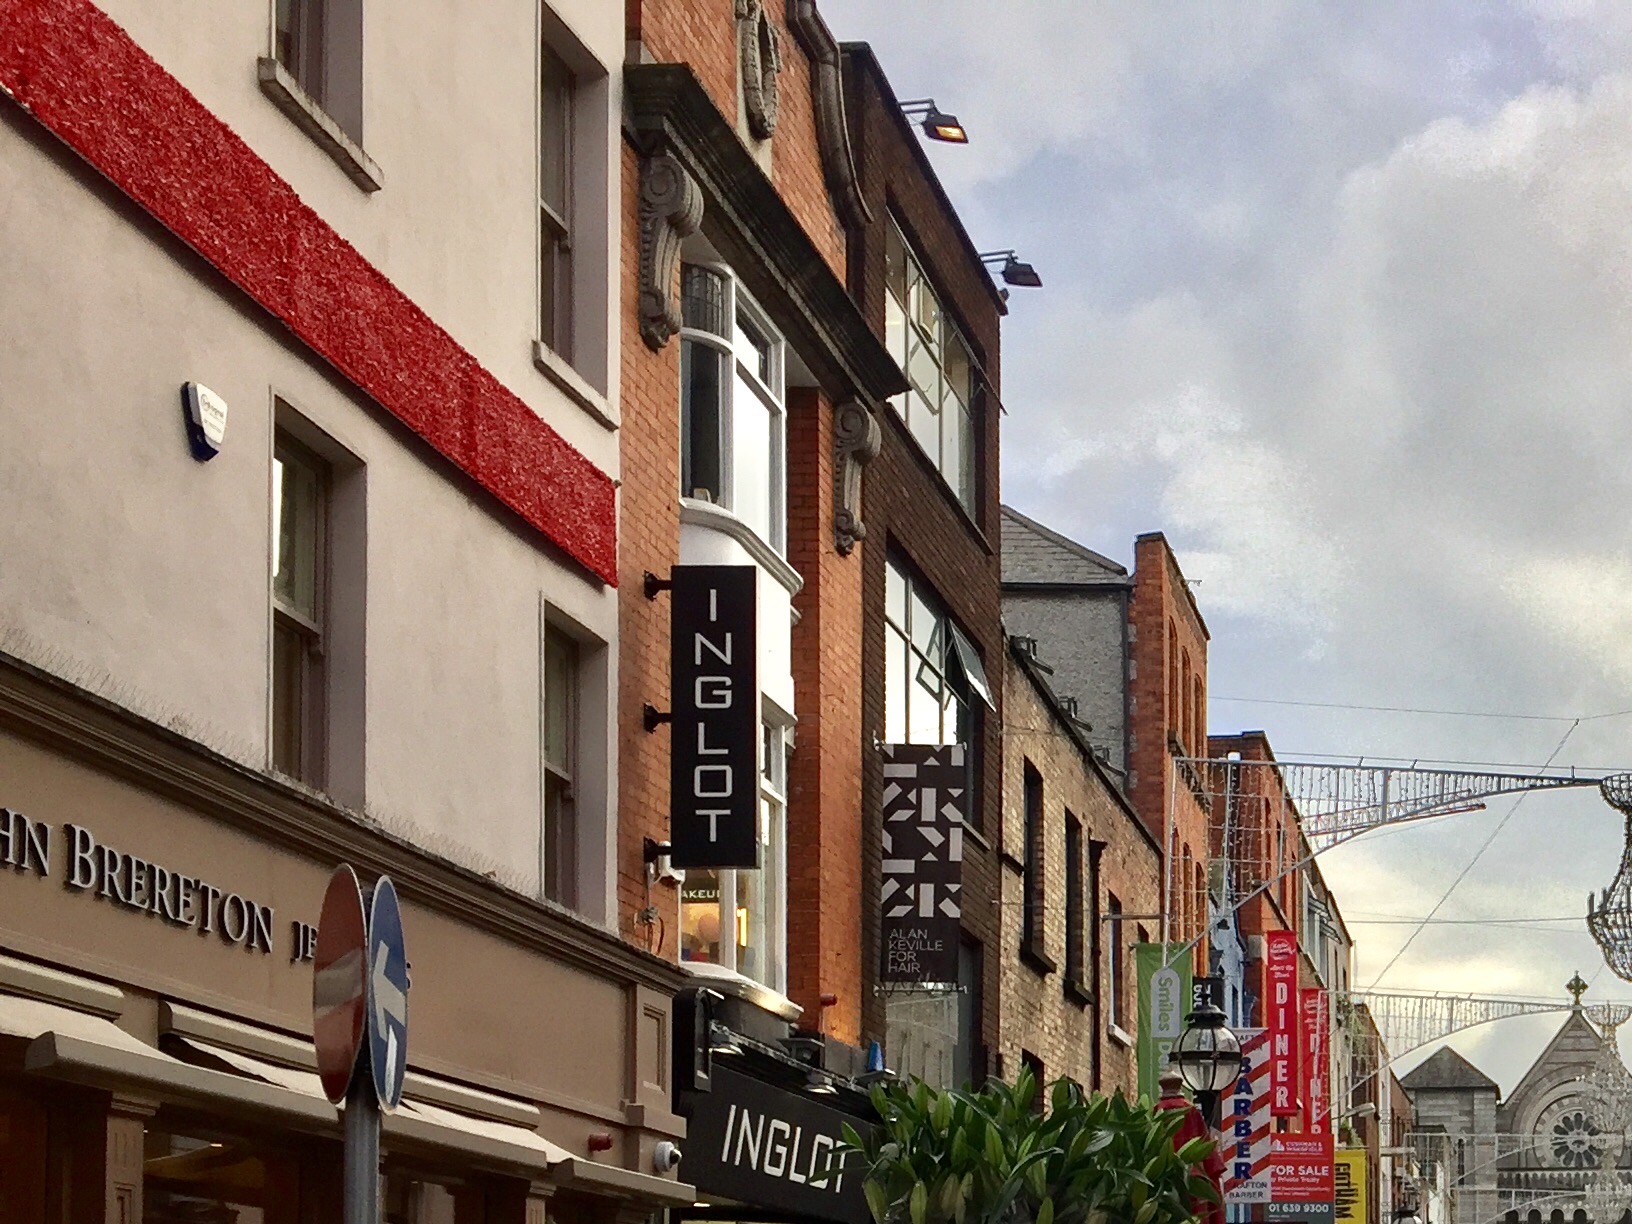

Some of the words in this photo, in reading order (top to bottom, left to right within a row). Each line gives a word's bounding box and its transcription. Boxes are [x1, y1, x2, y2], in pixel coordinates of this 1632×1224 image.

[694, 588, 733, 842] INGLOT
[66, 823, 275, 954] BRERETON
[680, 889, 720, 899] AKEU
[889, 928, 928, 940] ALAN
[888, 940, 944, 951] KEVILLE
[888, 951, 917, 962] FOR
[888, 962, 921, 973] HAIR
[1157, 976, 1174, 1032] Smiles
[1275, 982, 1289, 1109] DINER
[1233, 1056, 1254, 1180] BARBER
[721, 1104, 848, 1194] INGLOT
[1271, 1165, 1294, 1176] FOR
[1298, 1165, 1329, 1176] SALE
[1231, 1181, 1268, 1190] RAFTON
[1268, 1203, 1280, 1213] 01
[1282, 1203, 1301, 1213] 639
[1303, 1203, 1329, 1213] 9300
